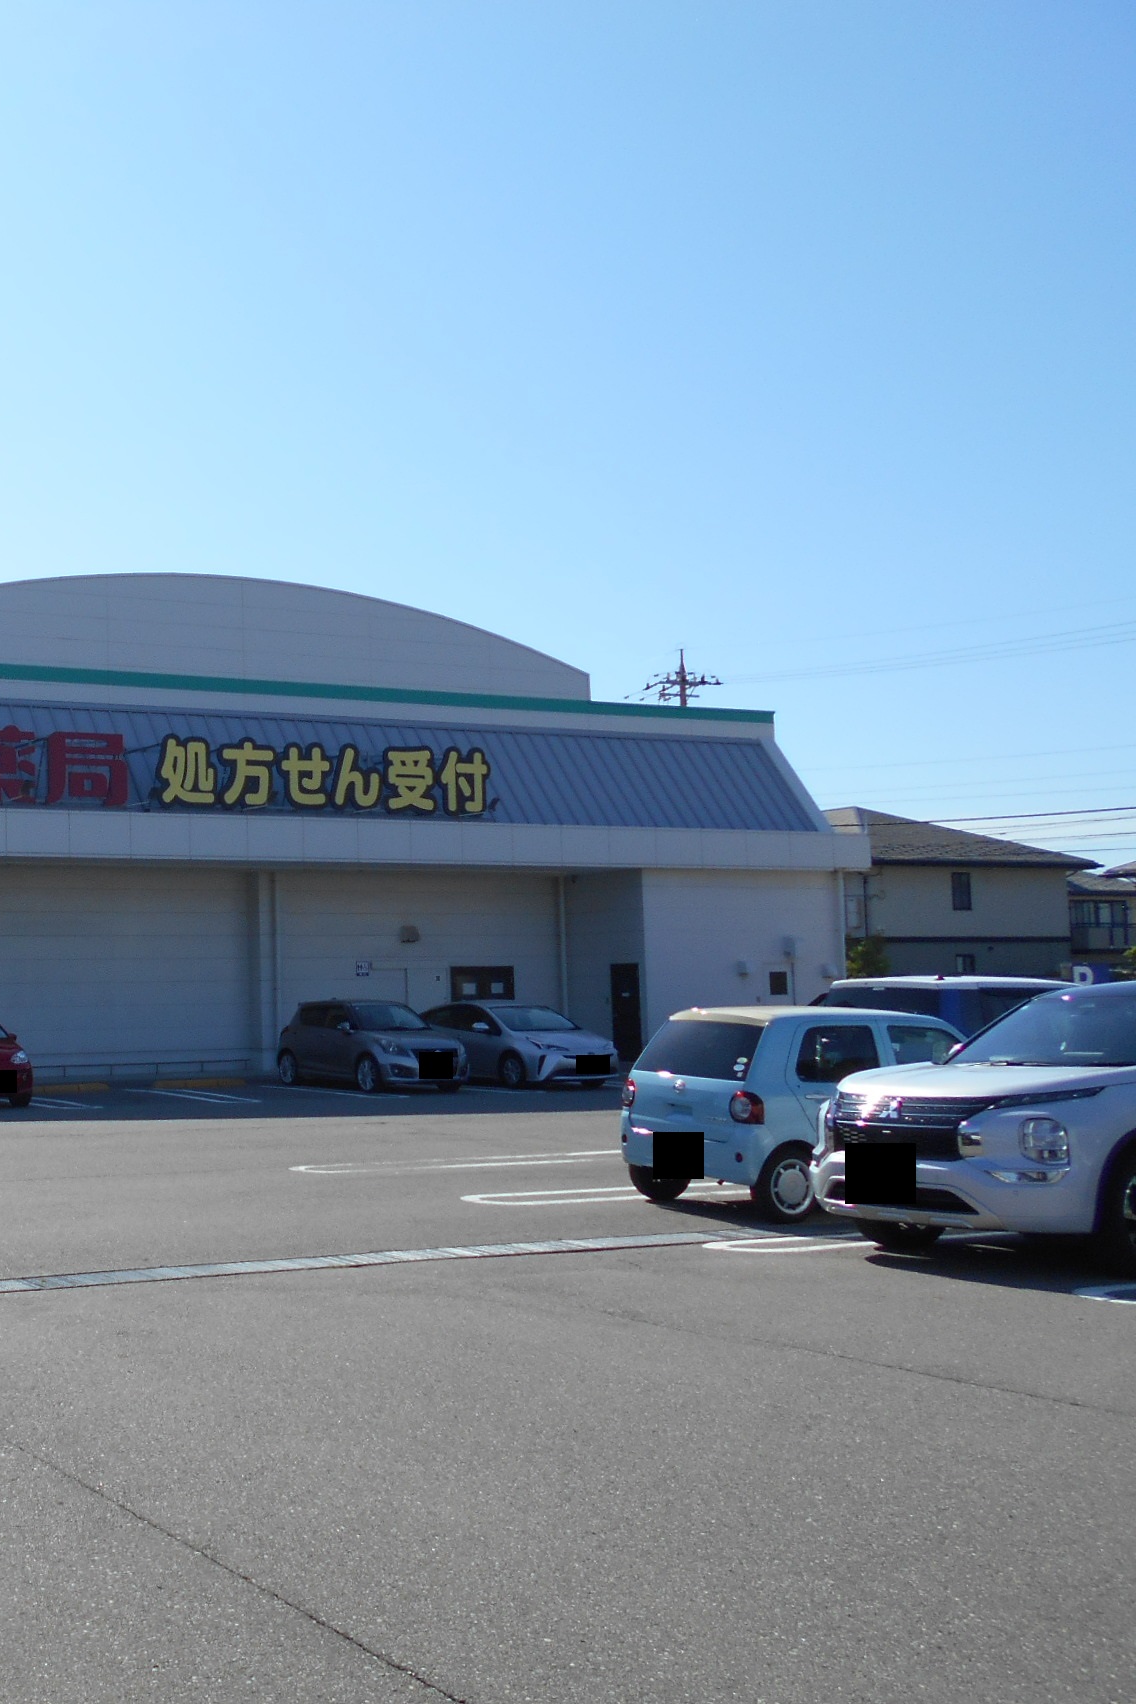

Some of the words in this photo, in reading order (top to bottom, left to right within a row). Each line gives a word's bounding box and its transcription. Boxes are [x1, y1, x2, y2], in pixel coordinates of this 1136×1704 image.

[159, 736, 491, 816] 処方せん受付
